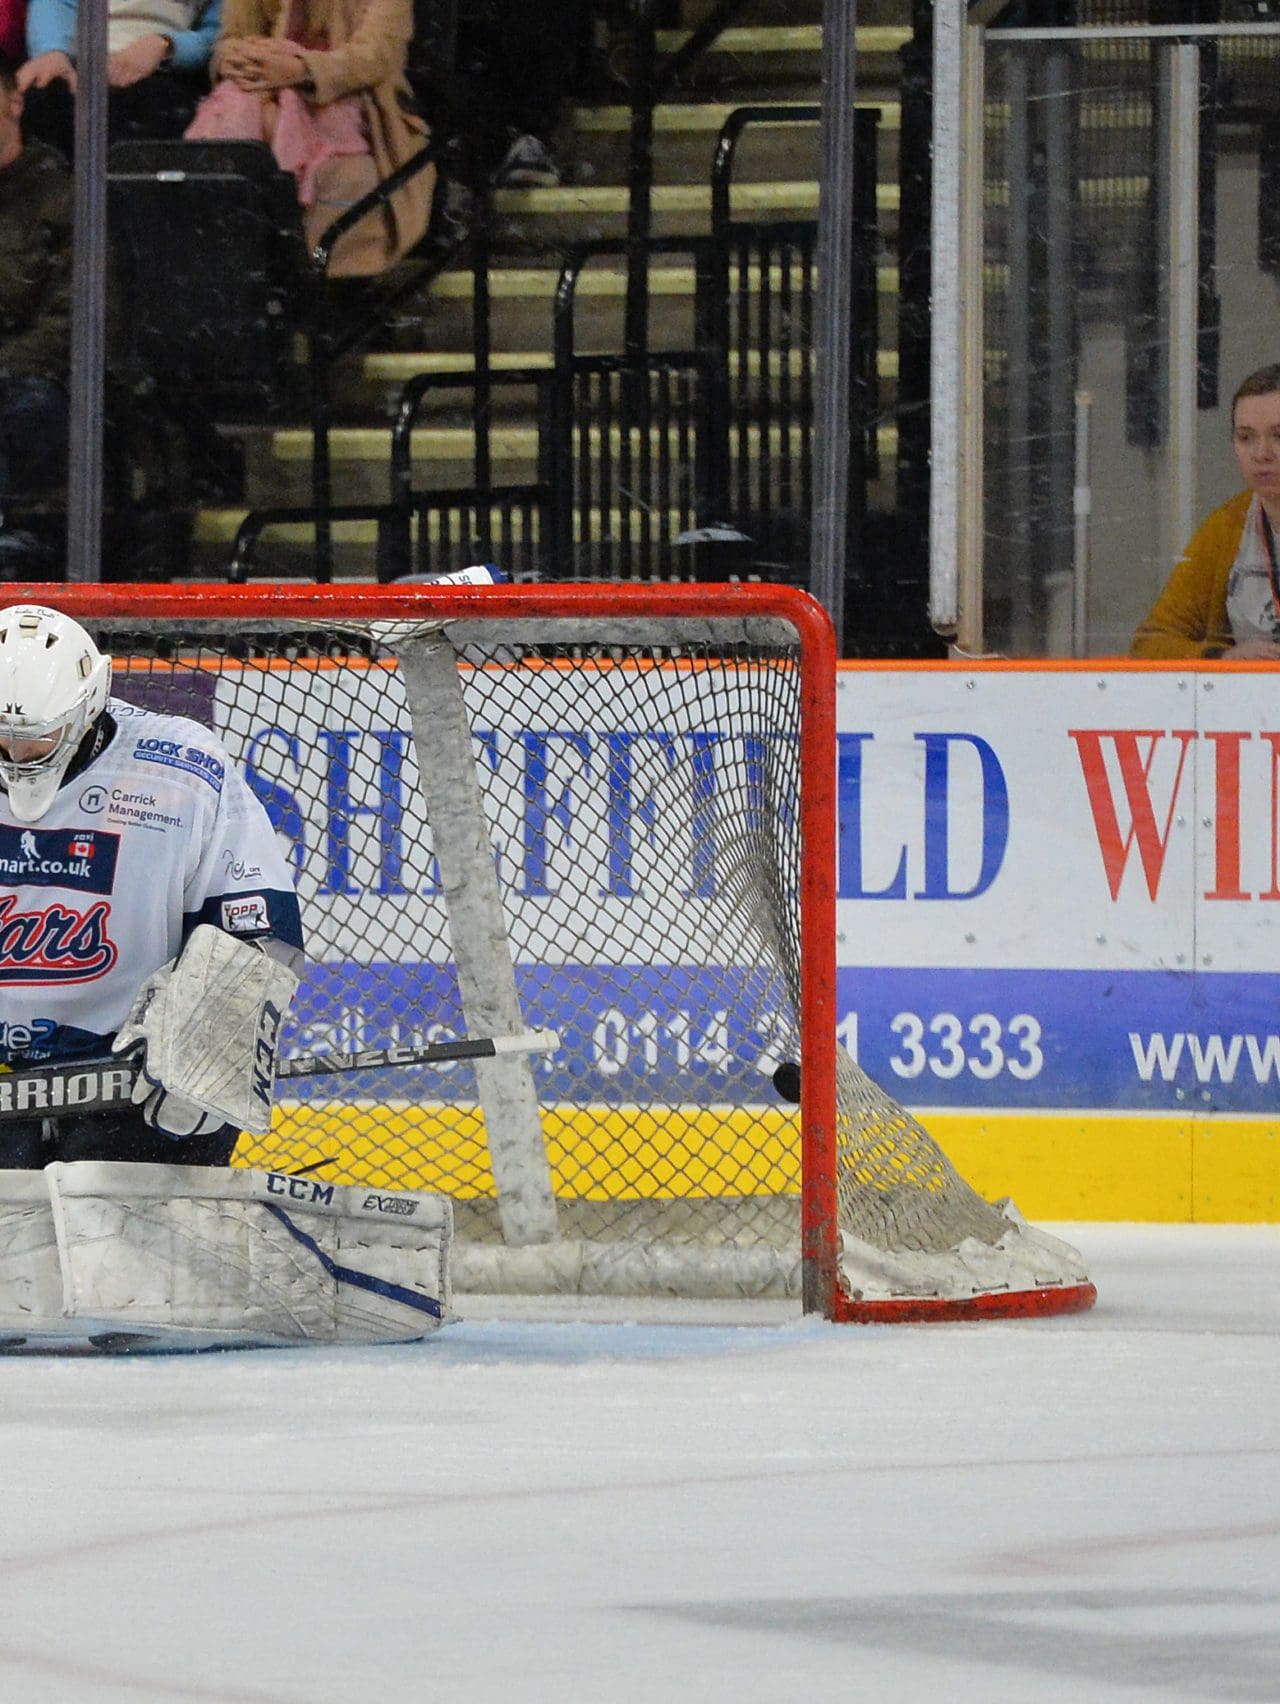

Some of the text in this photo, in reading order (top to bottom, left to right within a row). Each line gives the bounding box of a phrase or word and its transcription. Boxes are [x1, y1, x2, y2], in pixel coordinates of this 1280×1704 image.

[136, 738, 183, 757] LOCK
[111, 789, 157, 807] Carrick
[245, 727, 1280, 903] SHFFIELD WI
[591, 1008, 733, 1076] 0114
[890, 1012, 1043, 1080] 3333
[266, 1172, 335, 1207] CCM
